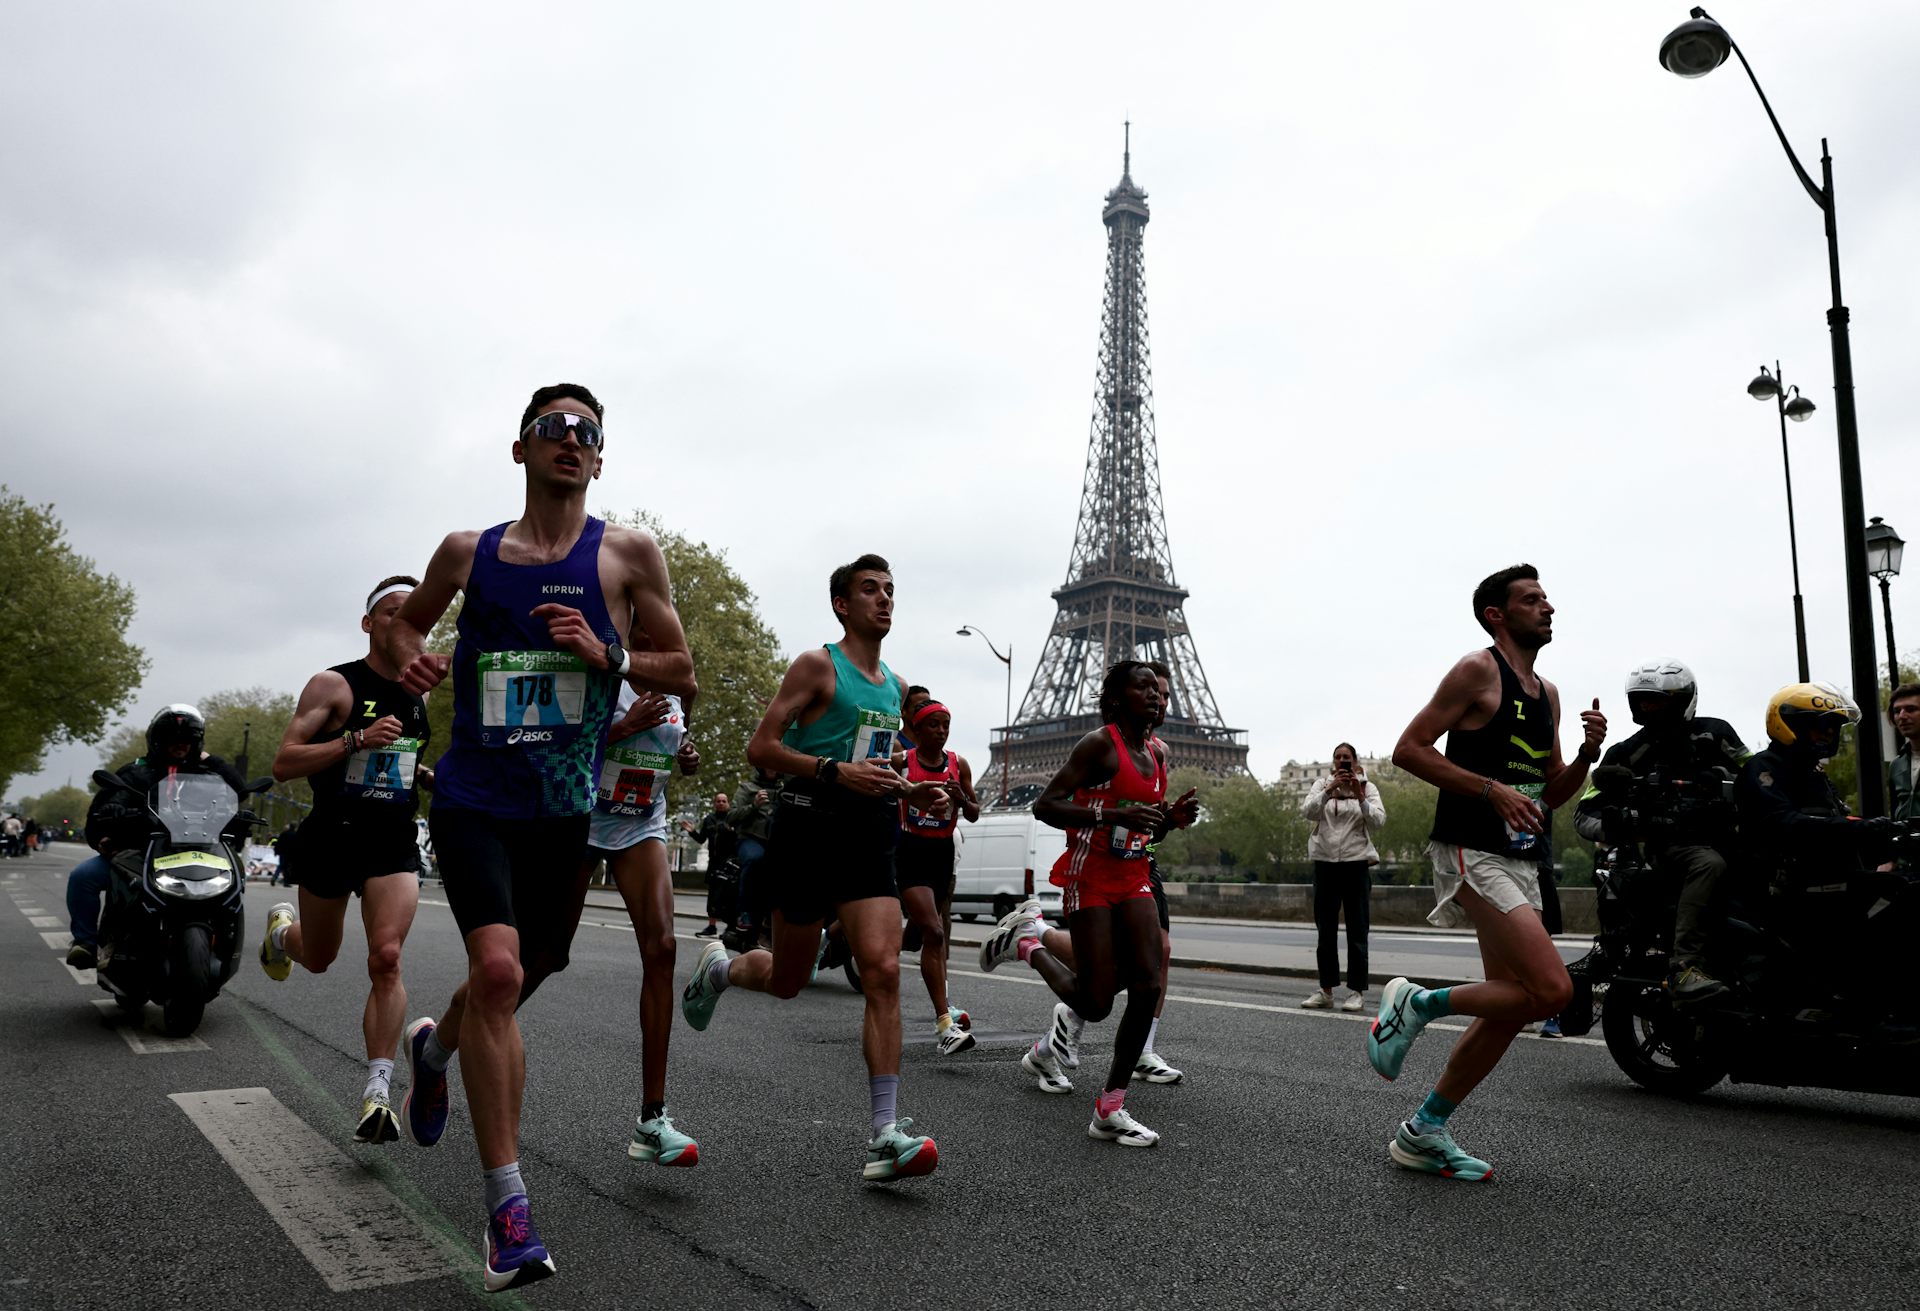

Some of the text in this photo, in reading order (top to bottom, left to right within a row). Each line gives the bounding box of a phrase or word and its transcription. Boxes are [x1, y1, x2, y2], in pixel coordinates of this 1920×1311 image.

[542, 585, 584, 595] KIPRUN
[507, 650, 575, 663] Schneider
[513, 676, 552, 706] 178
[393, 737, 412, 746] eider
[875, 731, 892, 753] 182
[375, 752, 395, 773] 97
[625, 749, 667, 763] Schneider
[597, 787, 611, 799] 206
